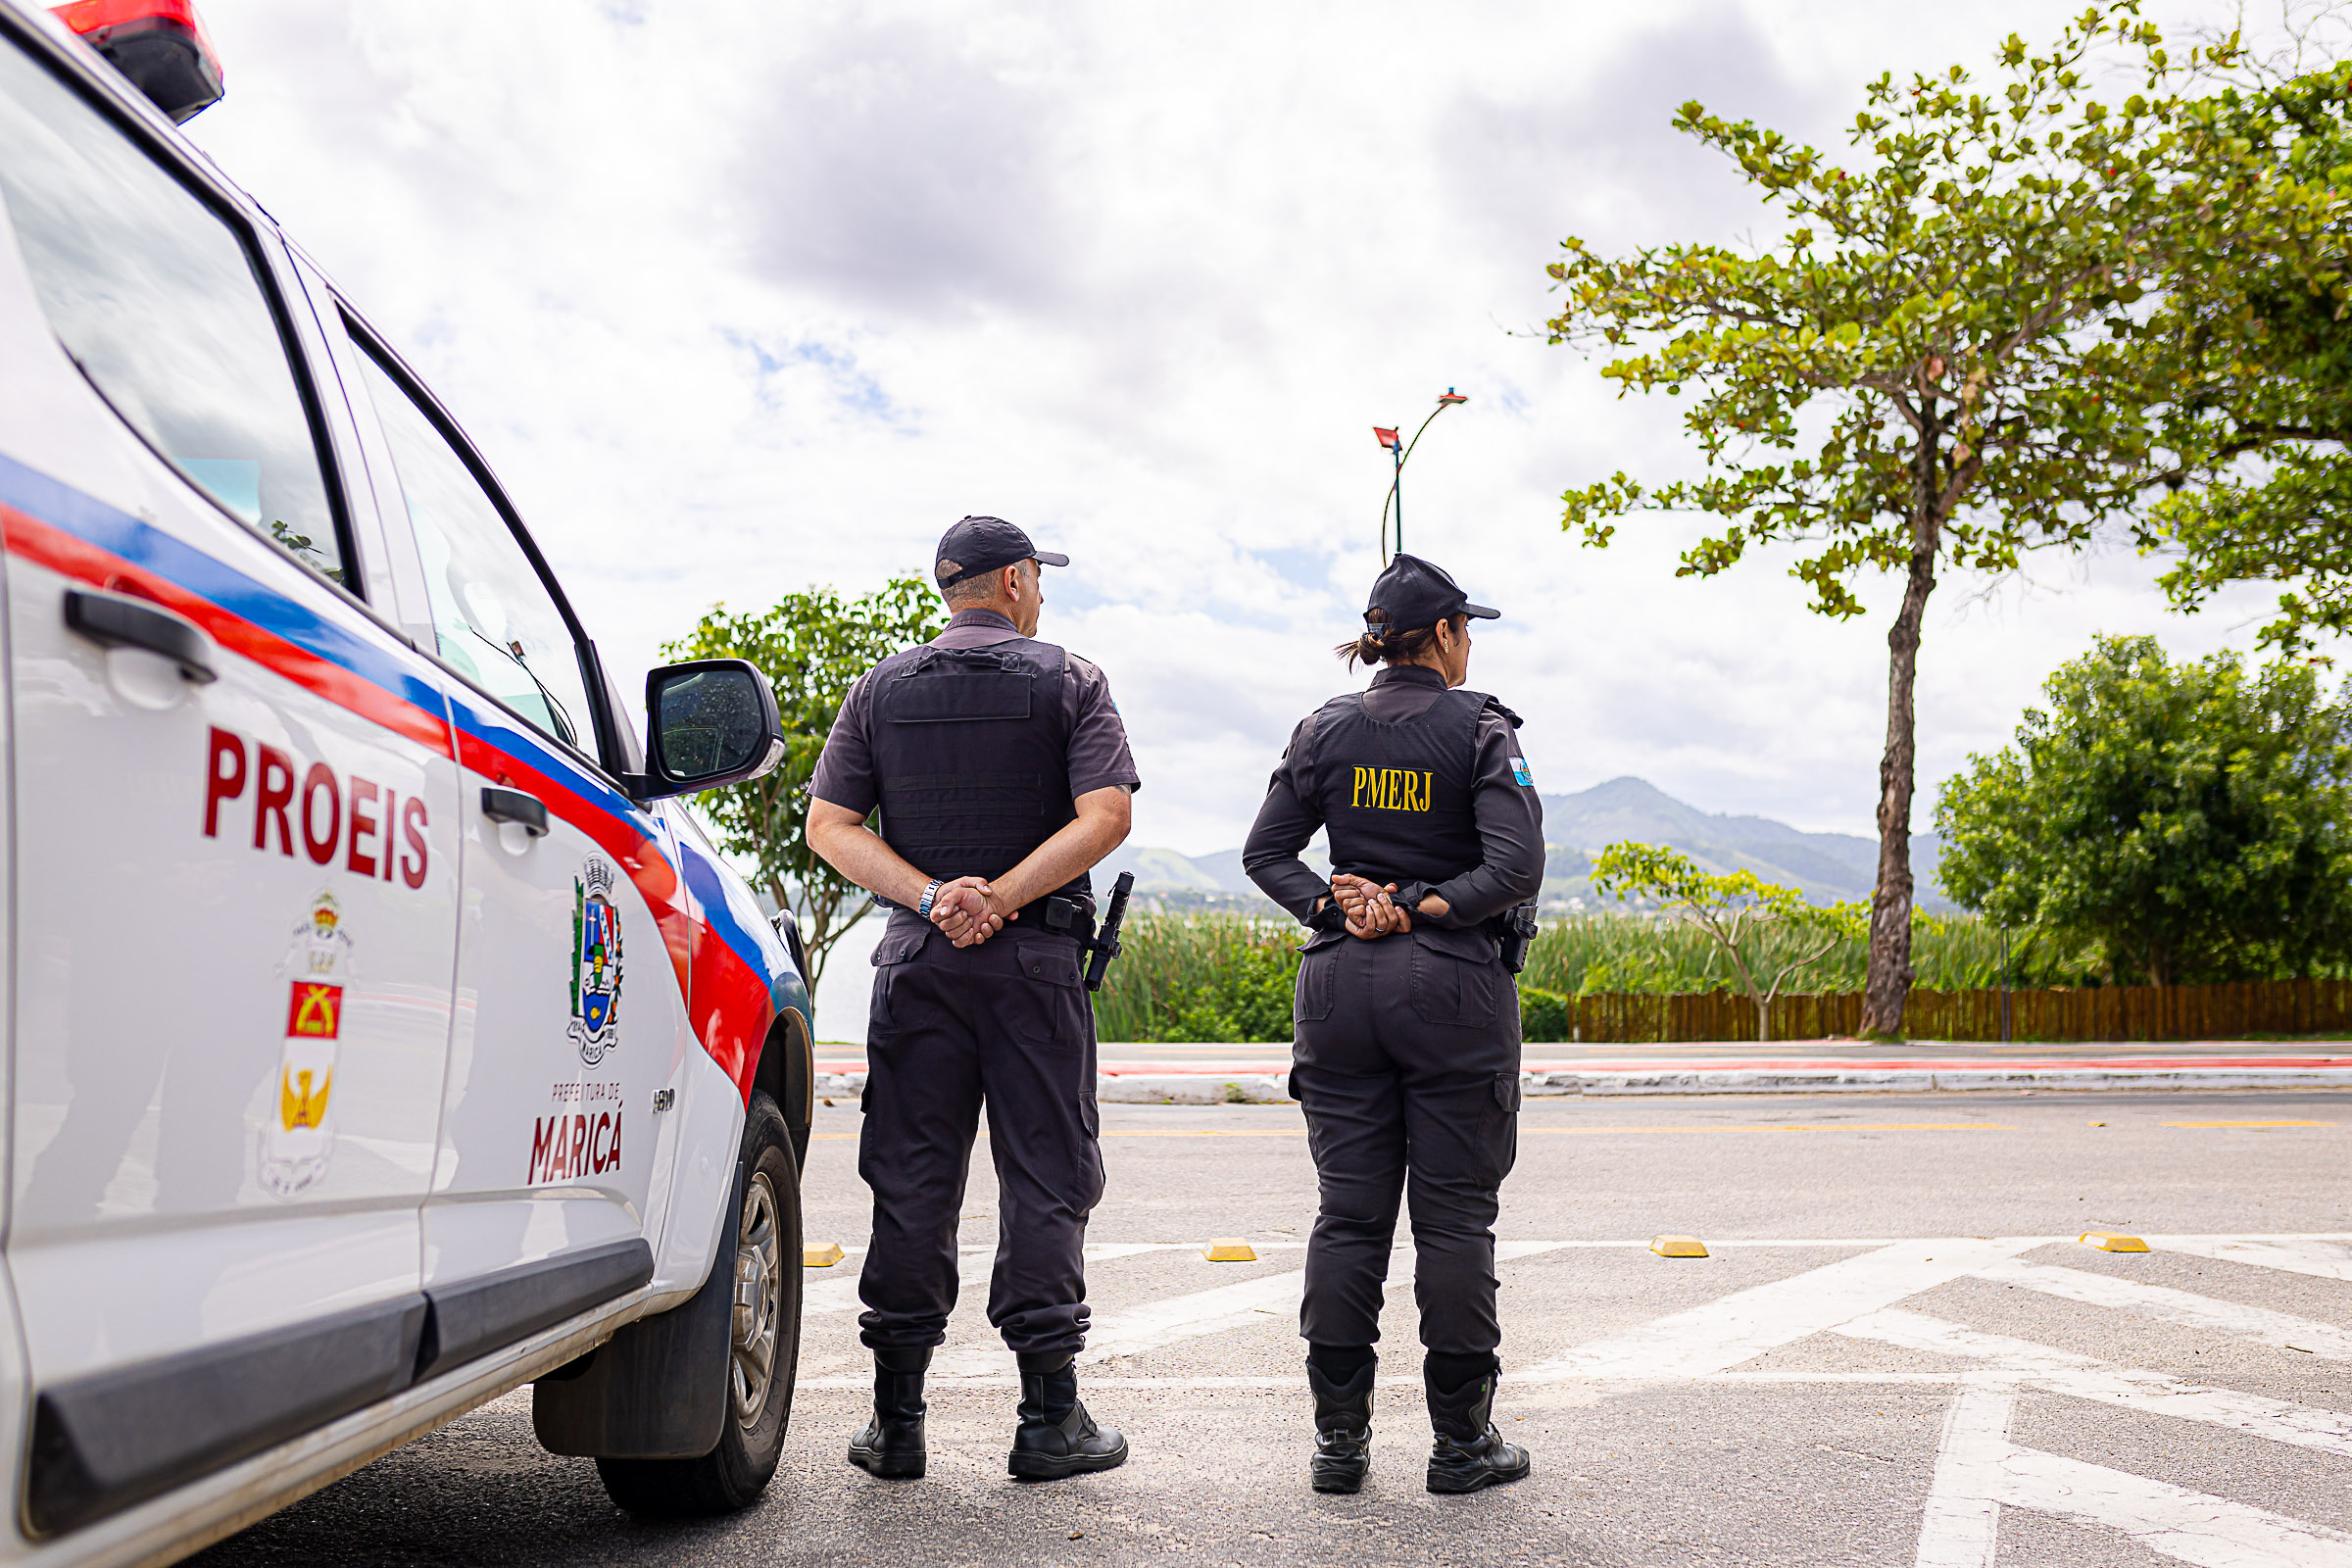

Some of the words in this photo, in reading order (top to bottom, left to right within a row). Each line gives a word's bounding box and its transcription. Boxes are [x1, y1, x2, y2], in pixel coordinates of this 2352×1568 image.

[204, 724, 428, 890] PROEIS
[1350, 766, 1434, 812] PMERJ
[552, 1082, 606, 1102] PREFEITURA
[608, 1082, 620, 1101] DE
[527, 1100, 623, 1186] MARICÁ
